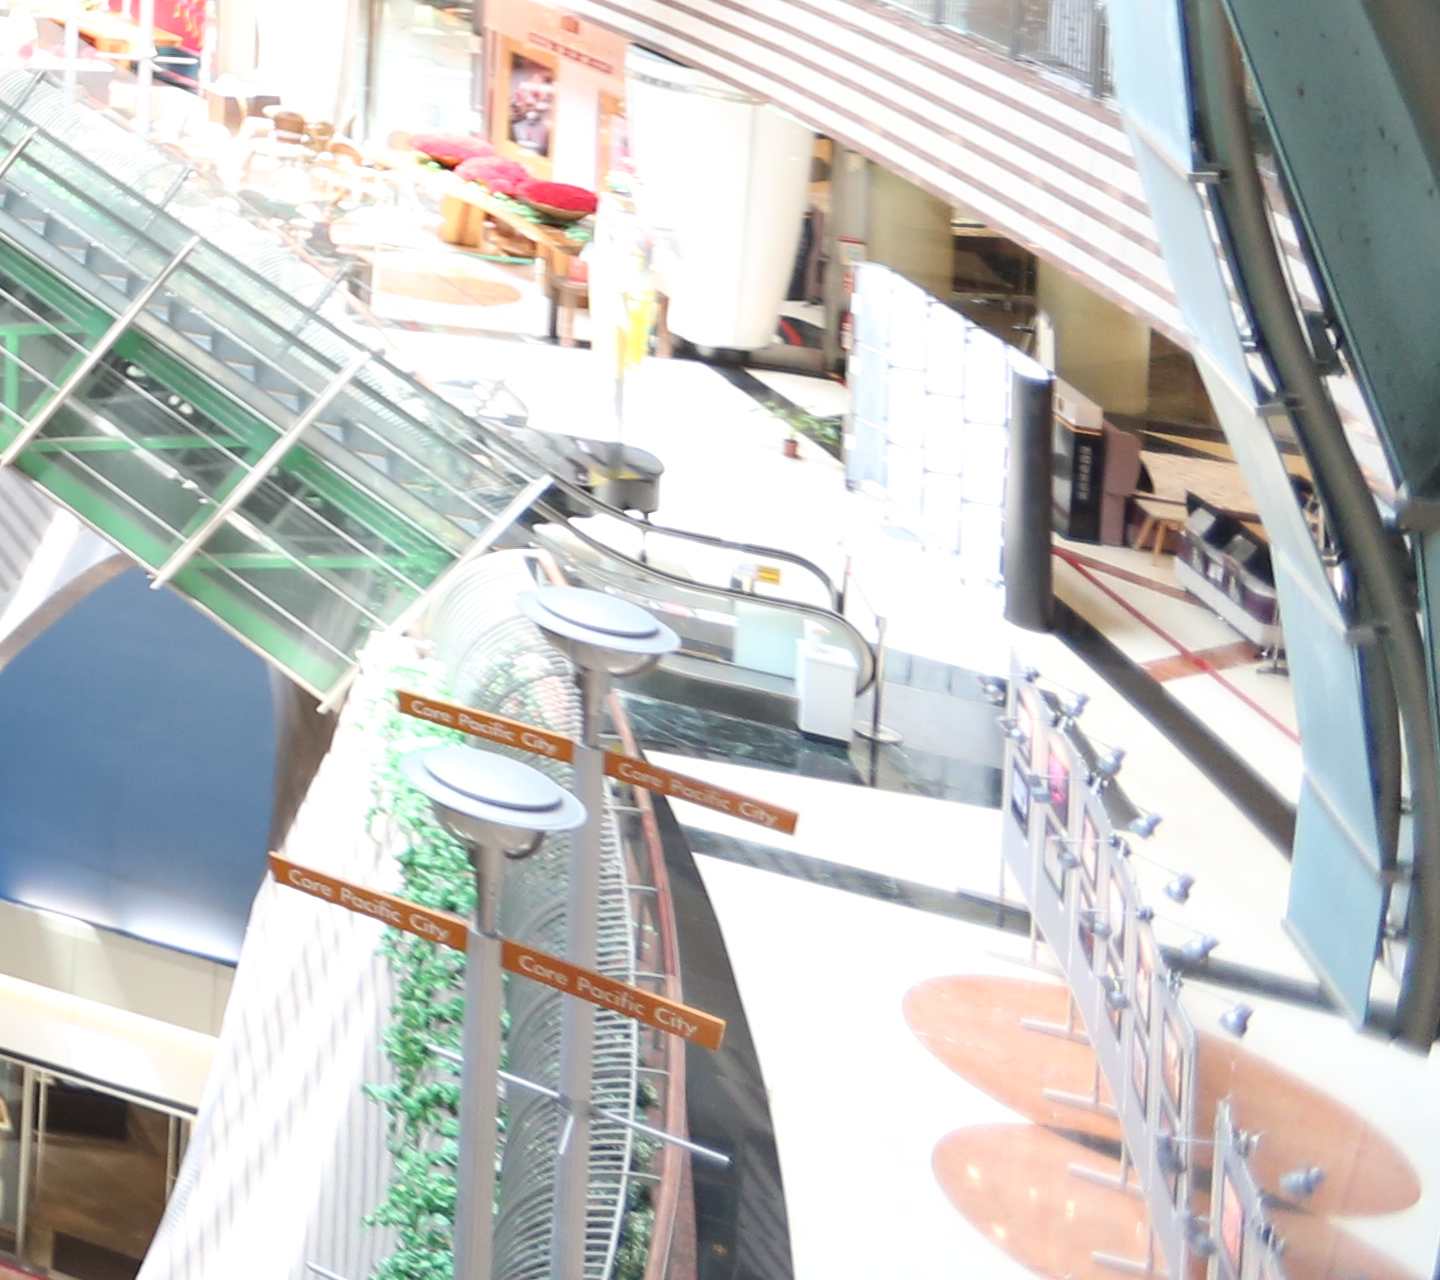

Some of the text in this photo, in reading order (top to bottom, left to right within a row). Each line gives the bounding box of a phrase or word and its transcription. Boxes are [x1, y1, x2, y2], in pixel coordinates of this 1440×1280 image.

[410, 699, 558, 754] Core Pacific City
[618, 763, 778, 826] Core Pacific City
[288, 869, 449, 940] Core Pacific City
[518, 954, 698, 1037] Core Pacific City
